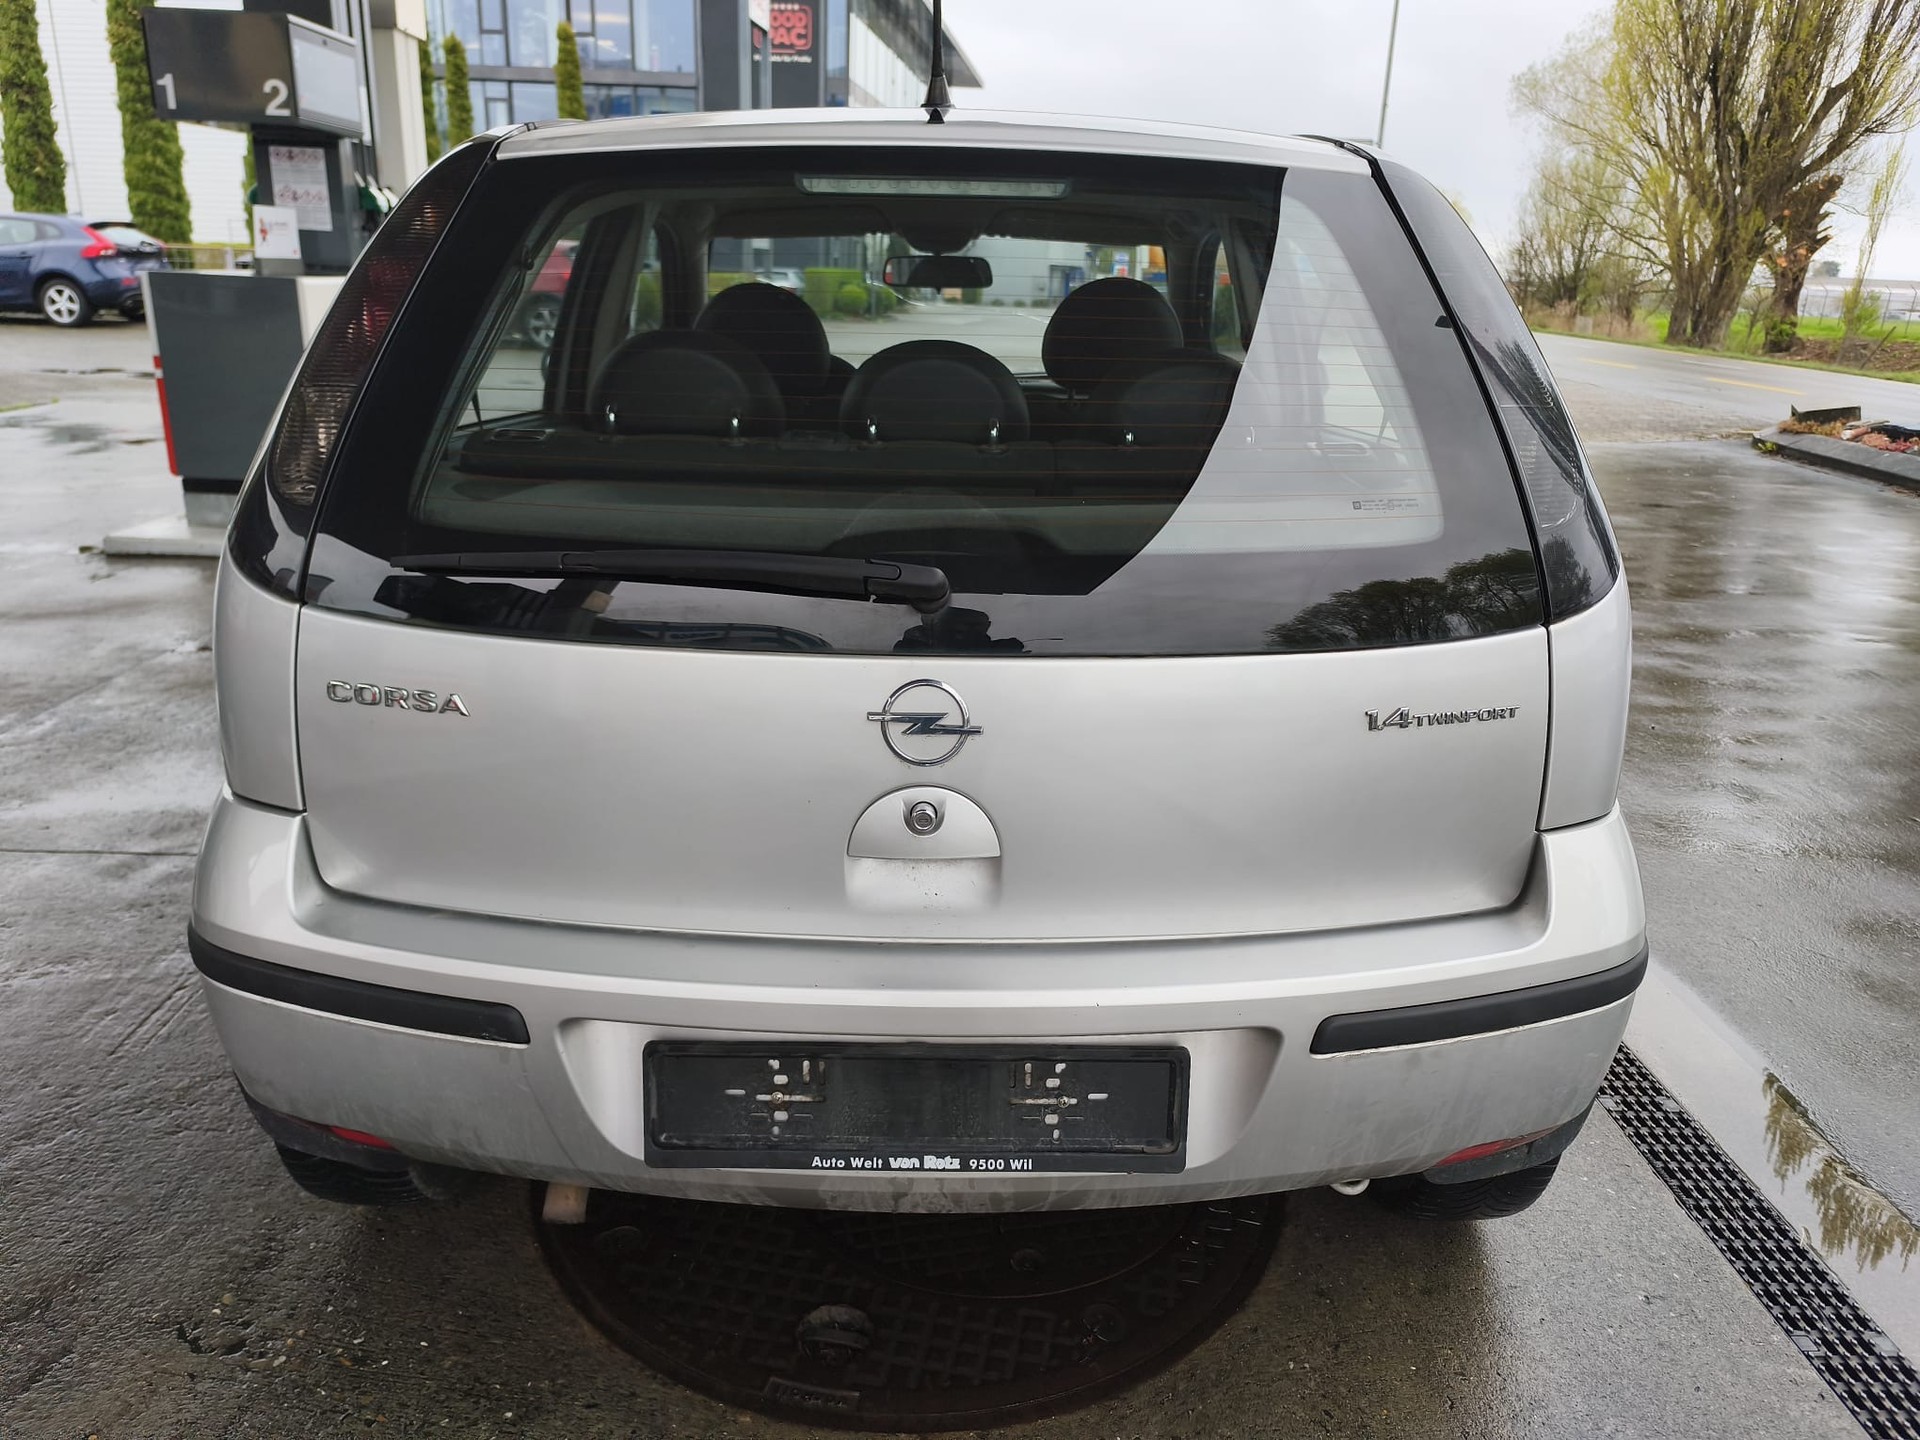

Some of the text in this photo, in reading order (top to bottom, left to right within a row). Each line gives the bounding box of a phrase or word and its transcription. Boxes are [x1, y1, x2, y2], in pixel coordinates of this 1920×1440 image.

[156, 73, 291, 117] 1 2
[326, 679, 470, 718] CORSA
[1413, 705, 1521, 727] TWINPORT
[811, 1155, 1033, 1171] Auto Welt von Rotz 9500 Wil
